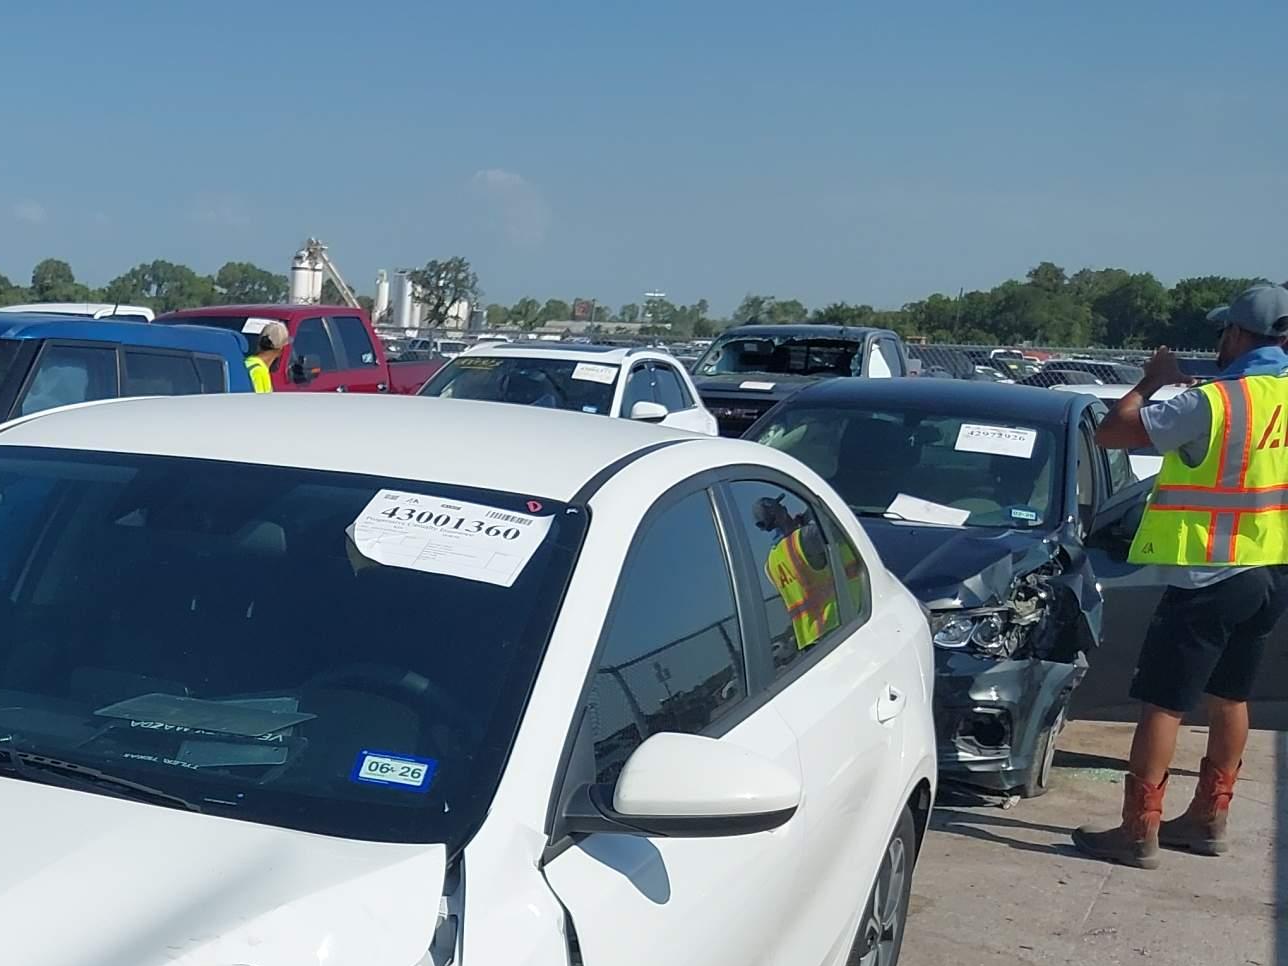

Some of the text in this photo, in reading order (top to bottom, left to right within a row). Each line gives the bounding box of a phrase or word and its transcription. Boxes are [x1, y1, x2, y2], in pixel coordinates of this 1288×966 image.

[381, 506, 521, 540] 43001360
[368, 761, 422, 779] 06 26
